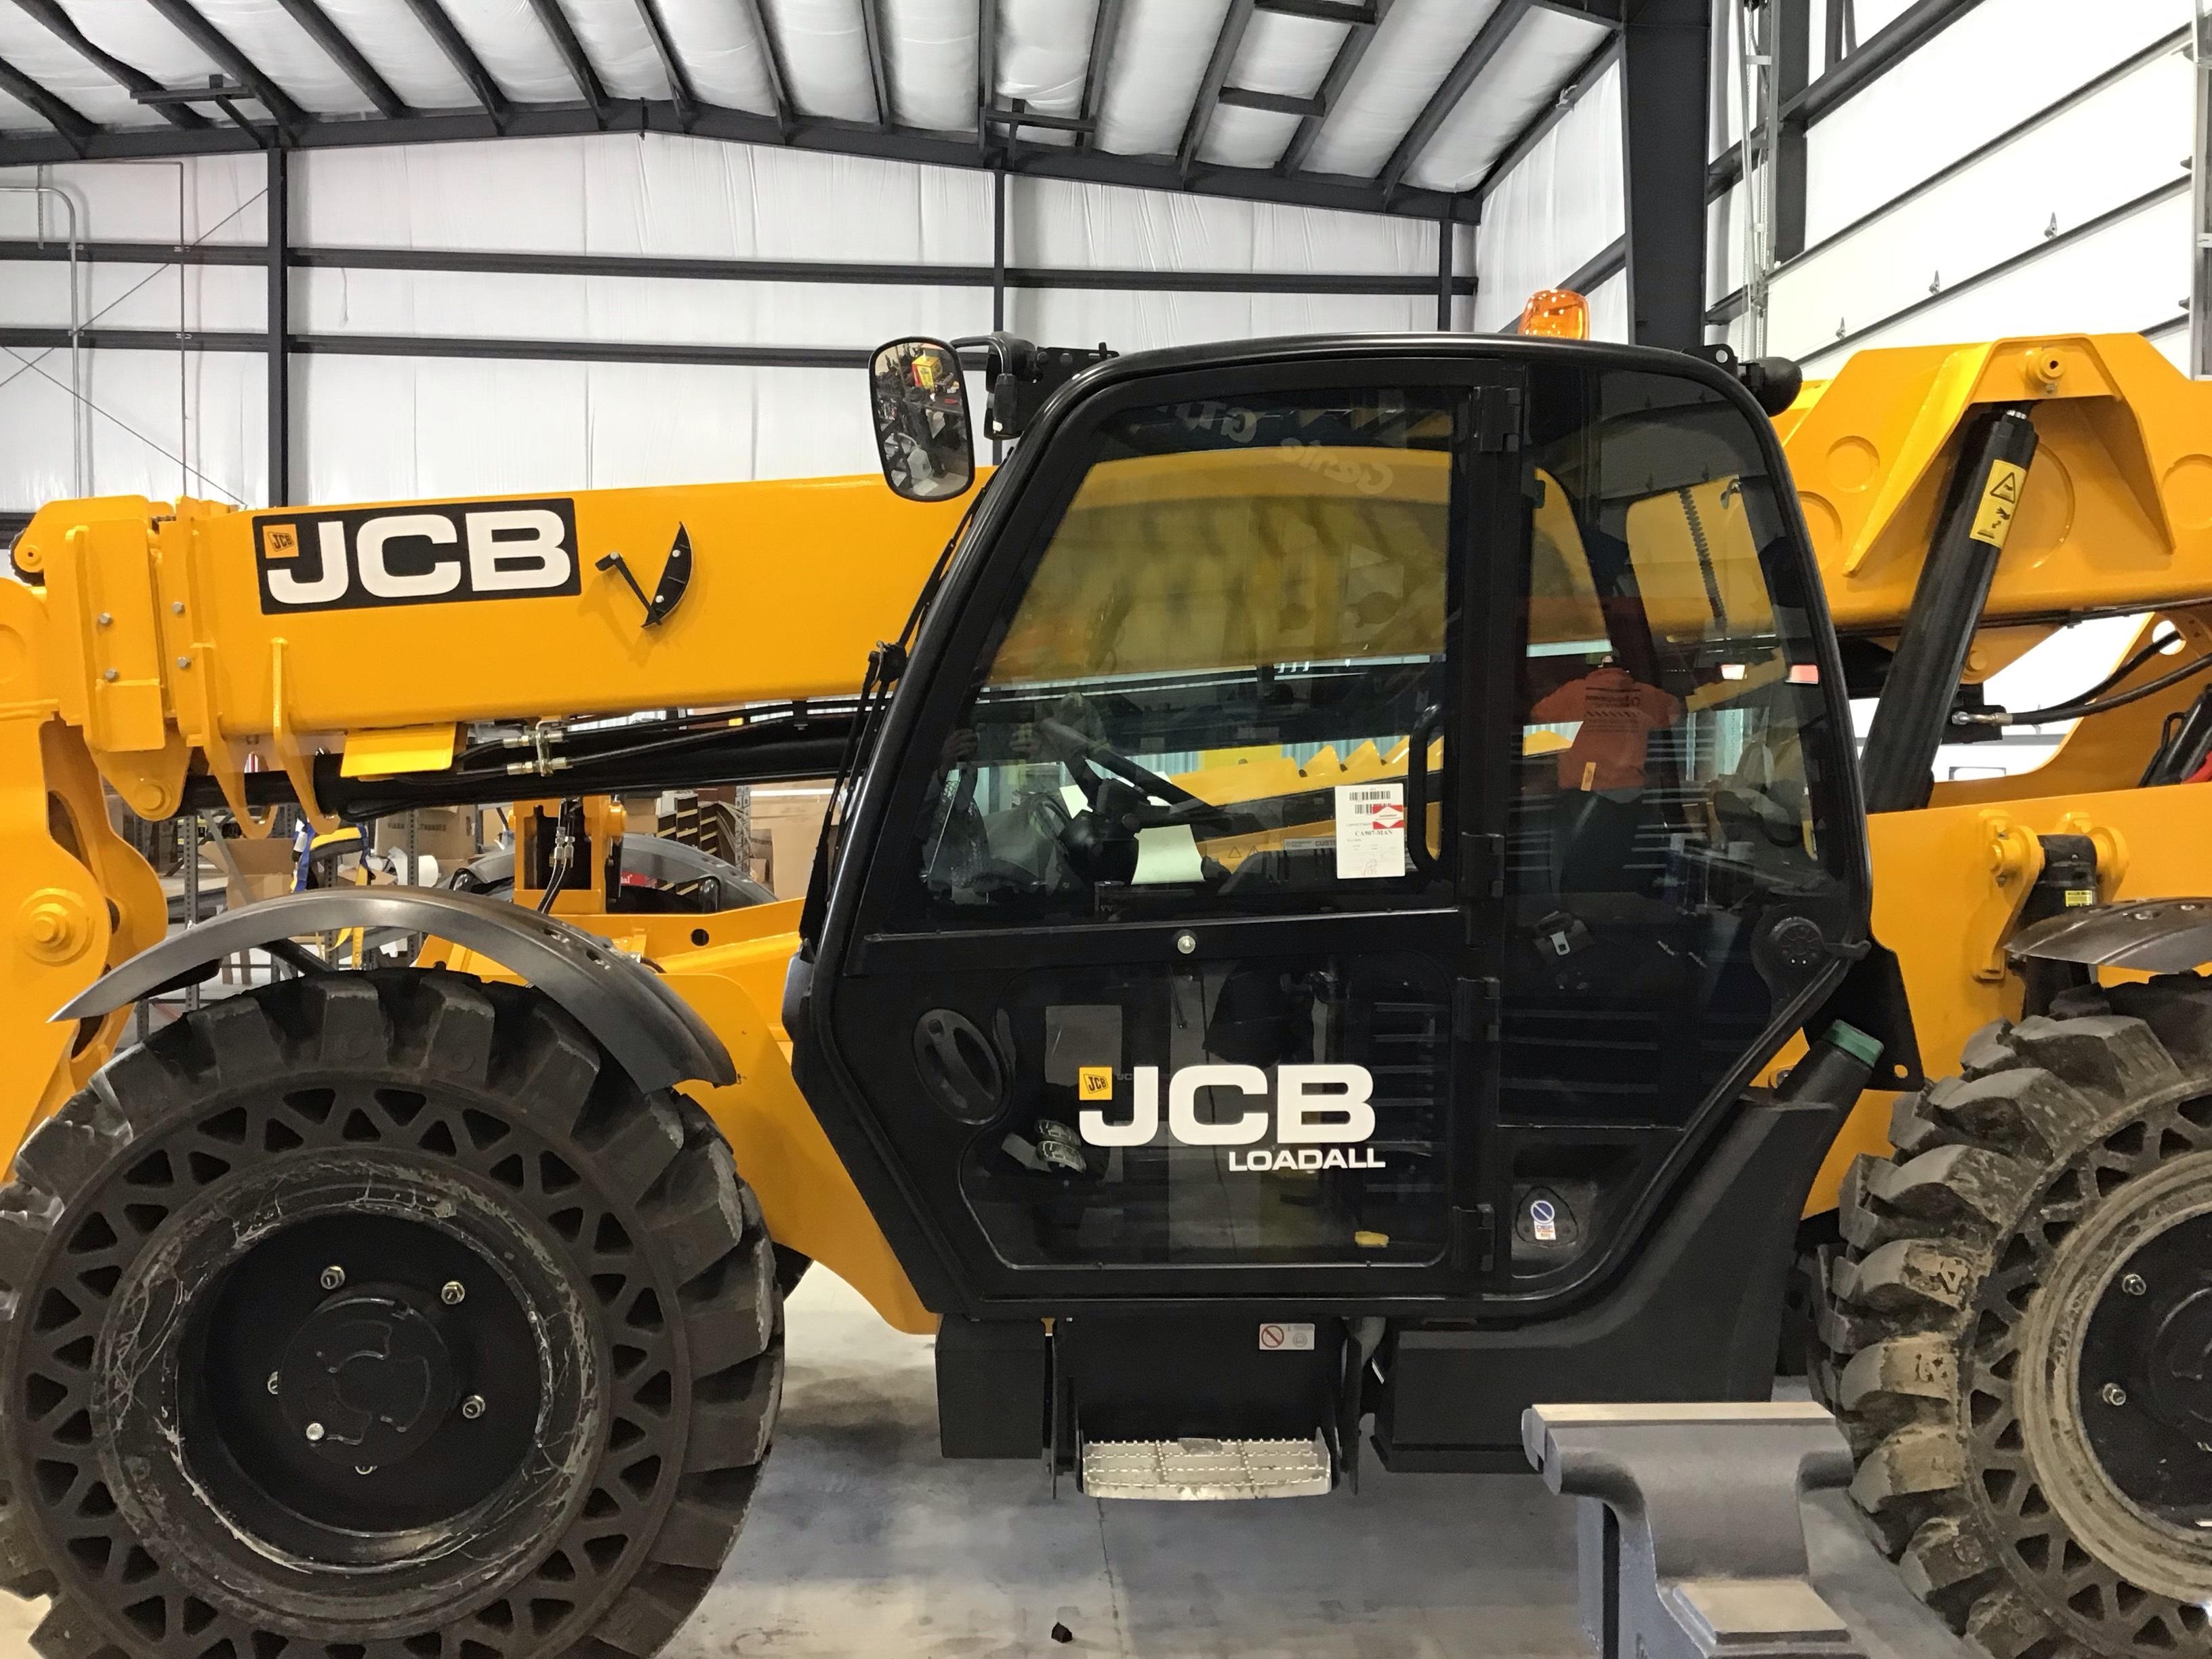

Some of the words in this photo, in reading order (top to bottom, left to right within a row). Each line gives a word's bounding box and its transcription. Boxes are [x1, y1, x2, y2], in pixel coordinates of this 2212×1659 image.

[272, 534, 292, 549] JCB
[267, 509, 571, 604] JCB
[1088, 1076, 1107, 1092] JCB
[1079, 1064, 1375, 1147] JCB
[1229, 1148, 1386, 1172] LOADALL
